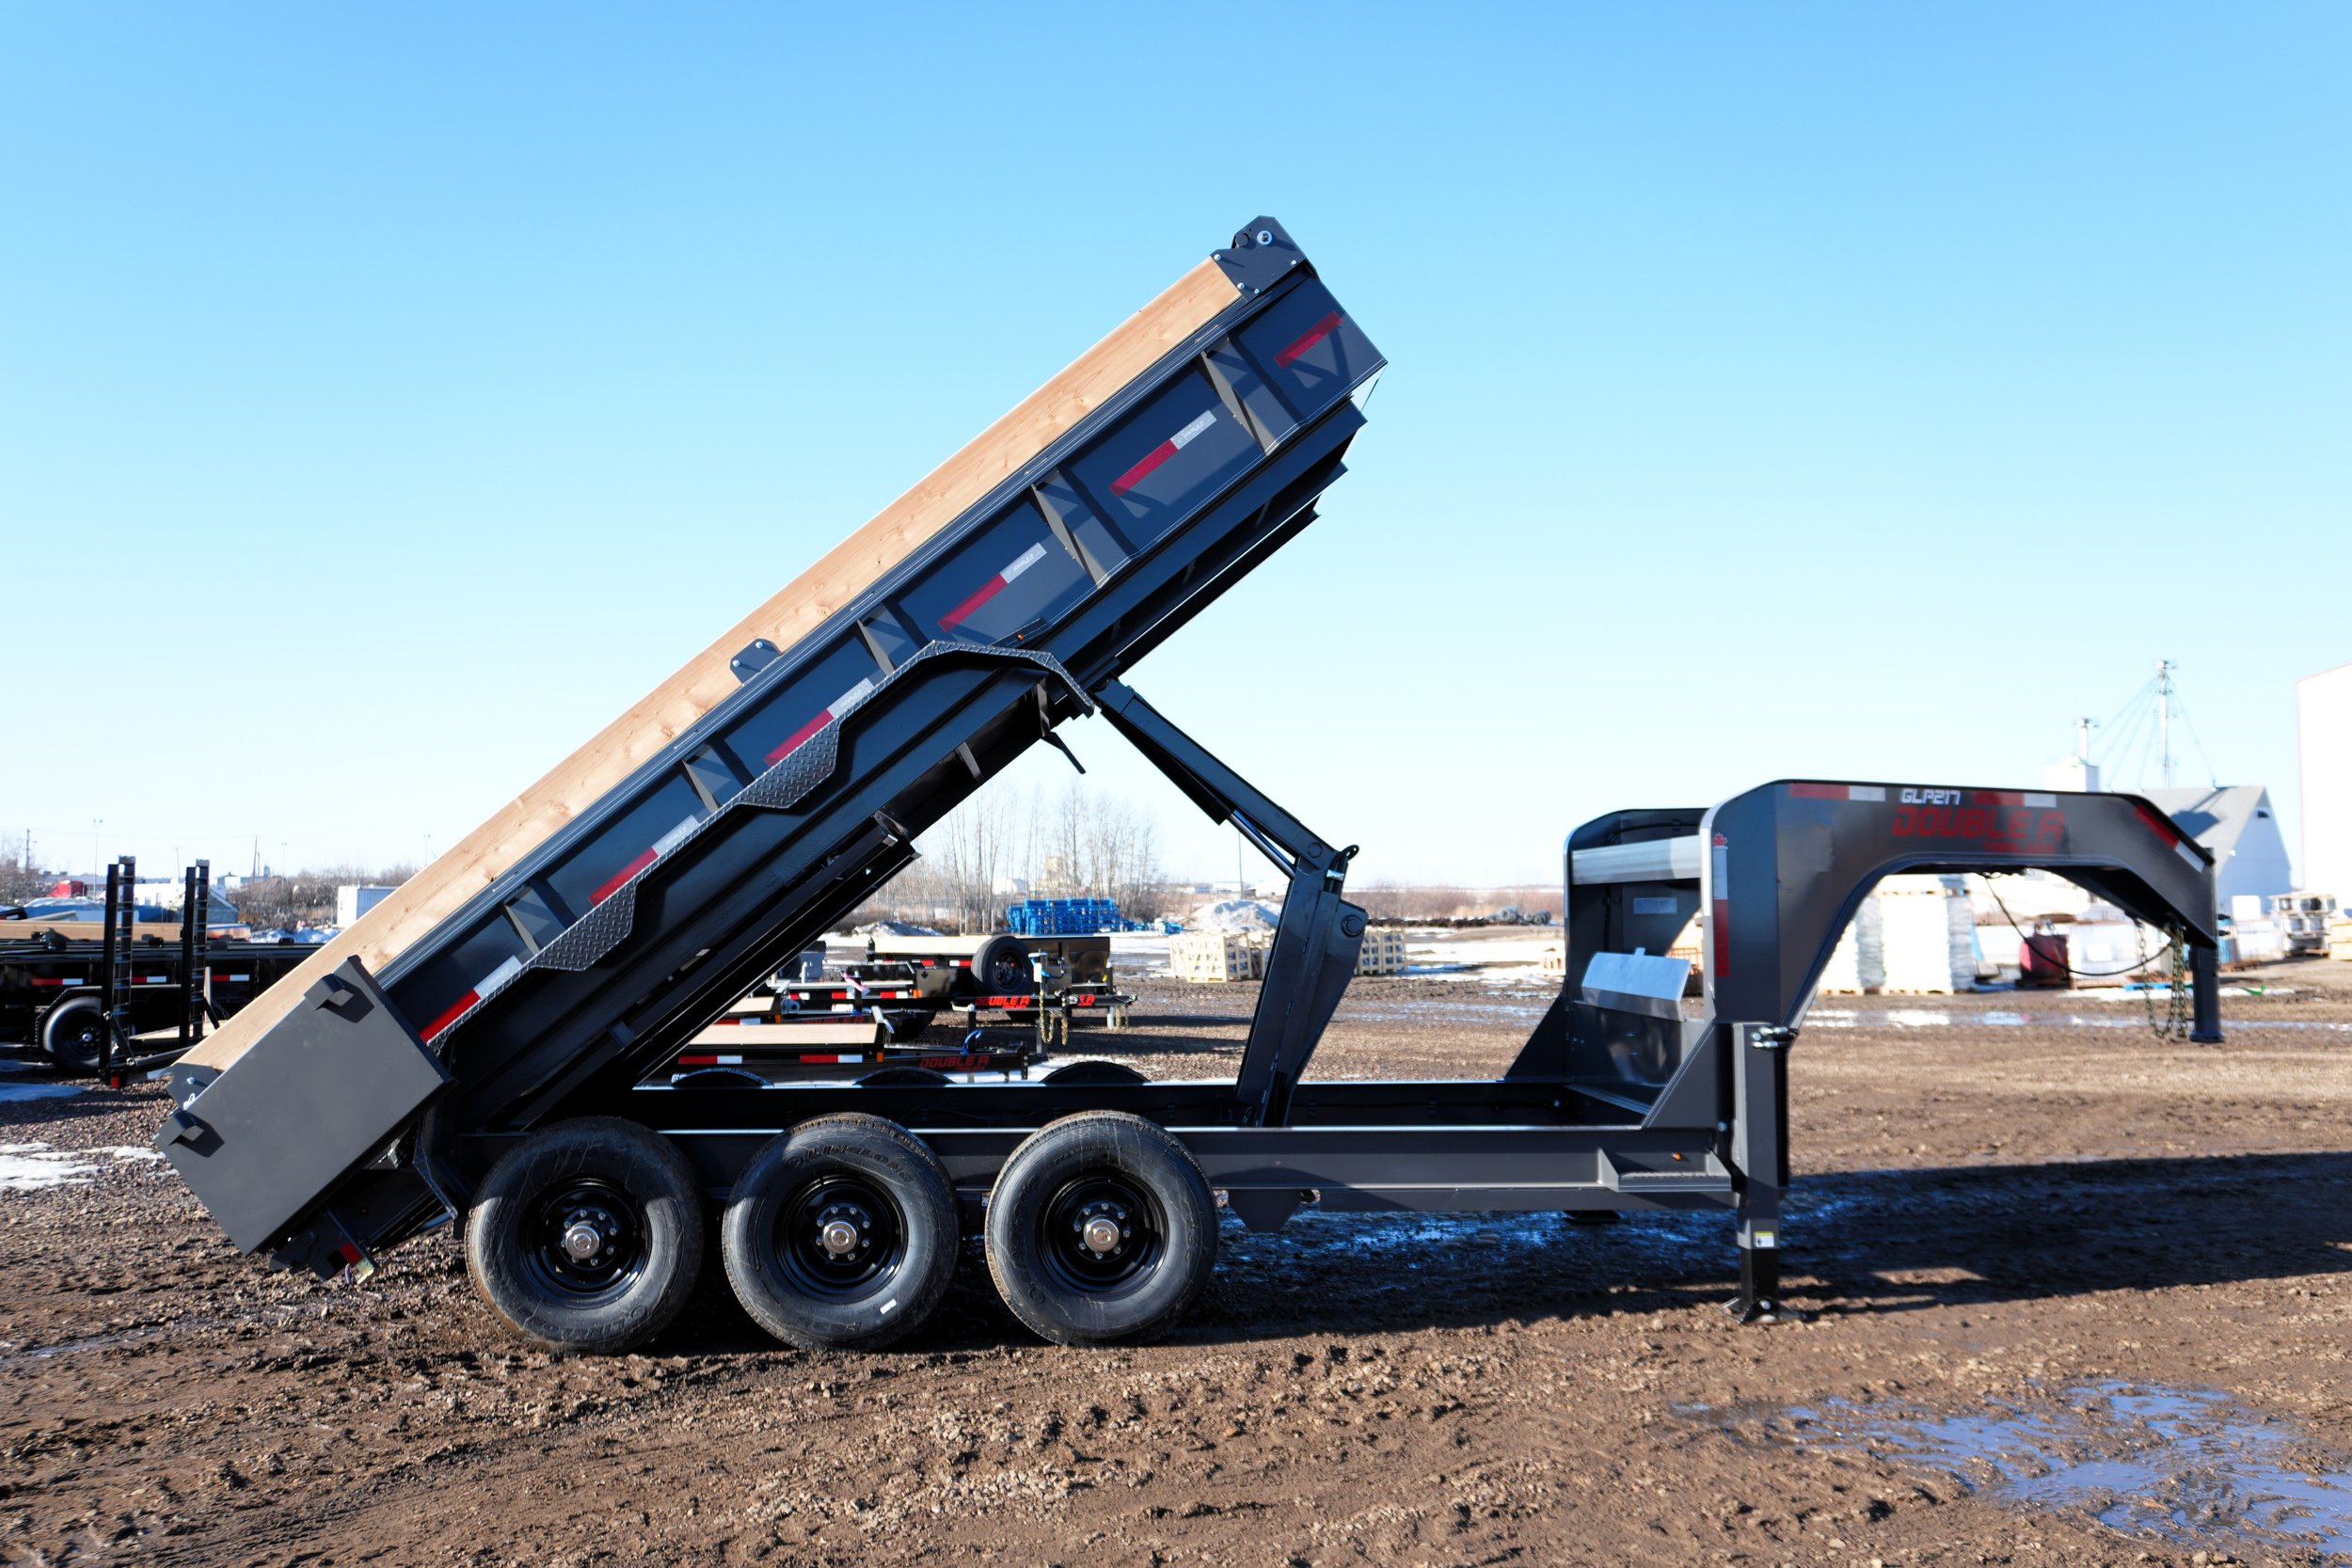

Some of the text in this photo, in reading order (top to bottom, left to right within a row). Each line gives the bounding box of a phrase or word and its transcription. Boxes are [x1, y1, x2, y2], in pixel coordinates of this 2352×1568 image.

[1901, 787, 1961, 805] GLP217
[1891, 806, 2065, 841] DOUBLE A
[922, 1054, 975, 1069] DOUBLE
